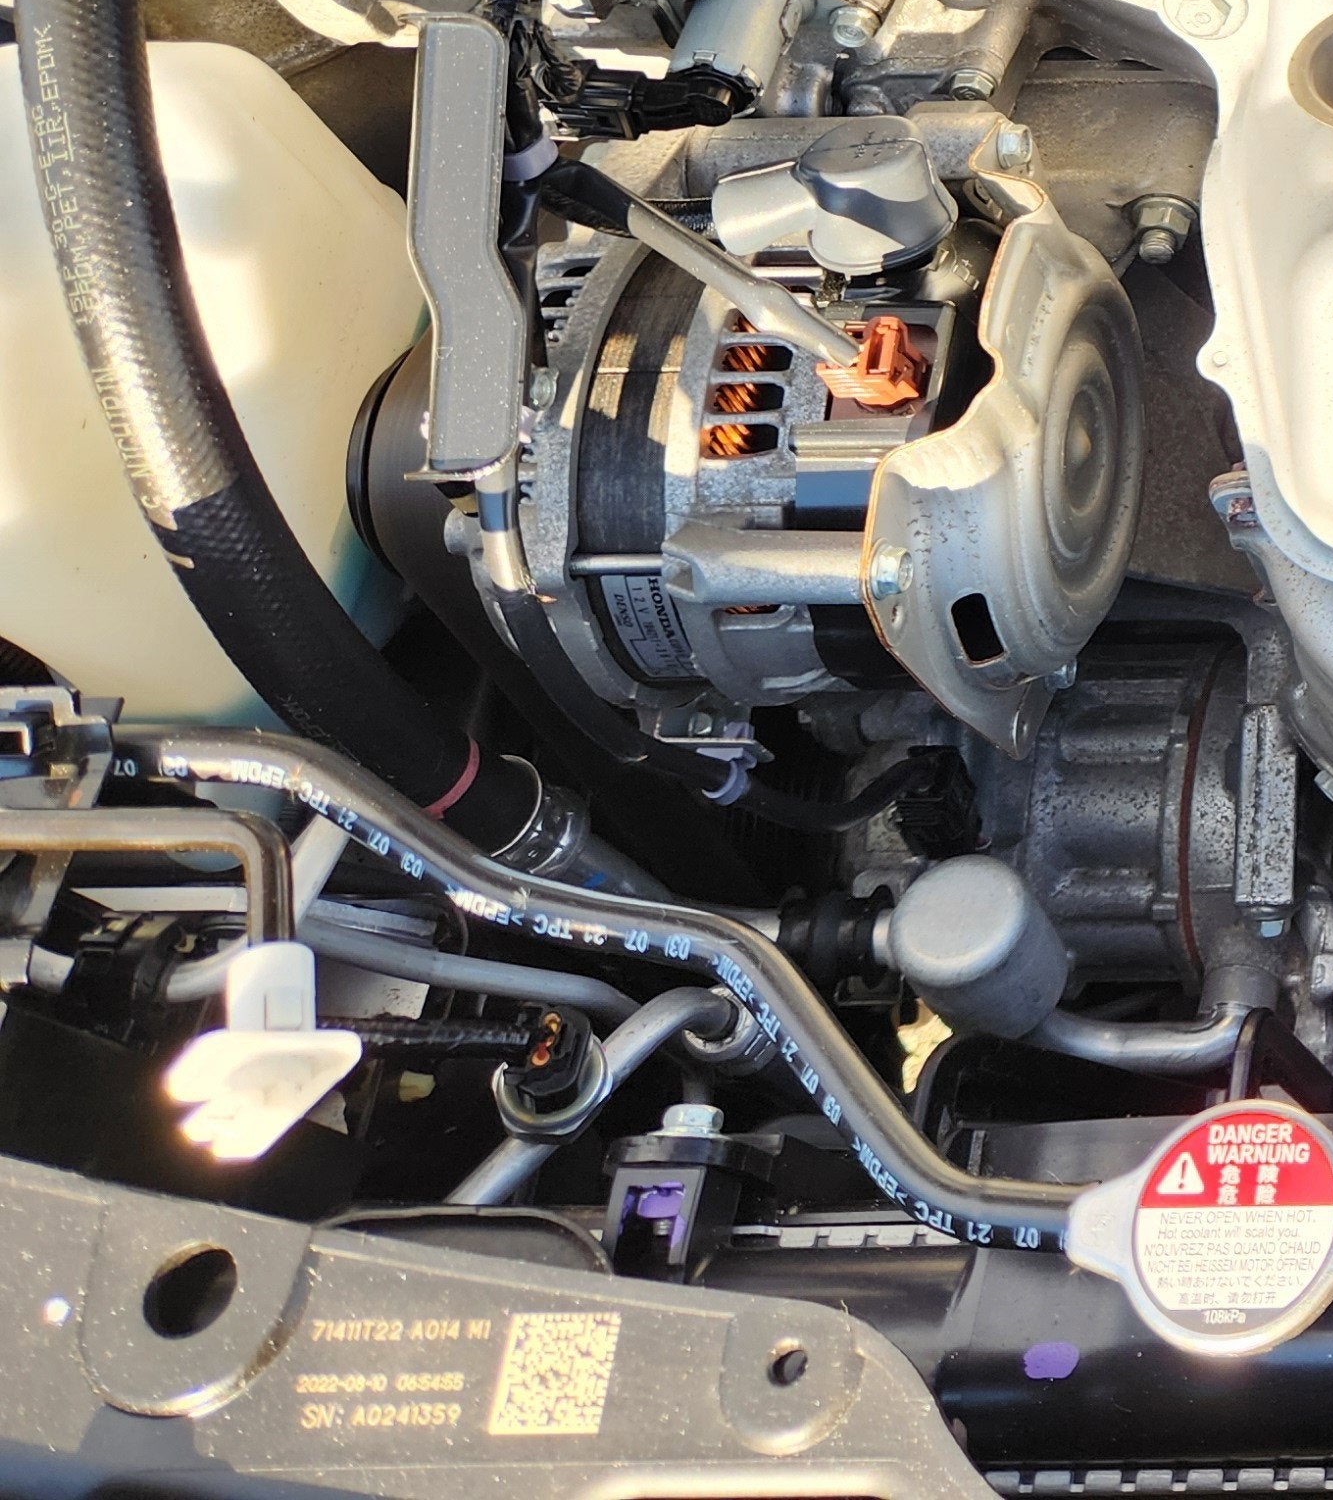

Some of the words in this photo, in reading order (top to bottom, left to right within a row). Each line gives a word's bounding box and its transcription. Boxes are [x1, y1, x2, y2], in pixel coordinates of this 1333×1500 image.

[613, 593, 634, 628] DENSO
[646, 577, 676, 639] HONDA
[298, 780, 331, 816] TPC
[532, 913, 574, 941] TPC
[755, 1003, 782, 1044] TPC
[1207, 1123, 1293, 1145] DANGER
[1207, 1142, 1311, 1165] WARNUNG
[913, 1200, 956, 1235] TPC
[1160, 1211, 1203, 1226] NEVER
[1205, 1210, 1241, 1225] OPEN
[1244, 1210, 1284, 1224] WHEN
[1157, 1227, 1177, 1240] Hot
[1180, 1227, 1221, 1240] coolant
[1224, 1226, 1242, 1239] will
[1244, 1225, 1275, 1239] scald
[1206, 1242, 1234, 1256] PAS
[1233, 1241, 1277, 1256] QUAND
[1279, 1241, 1322, 1255] CHAUD
[1239, 1258, 1274, 1272] MOTOR
[408, 1317, 462, 1342] A014
[1202, 1309, 1247, 1326] 108kPa
